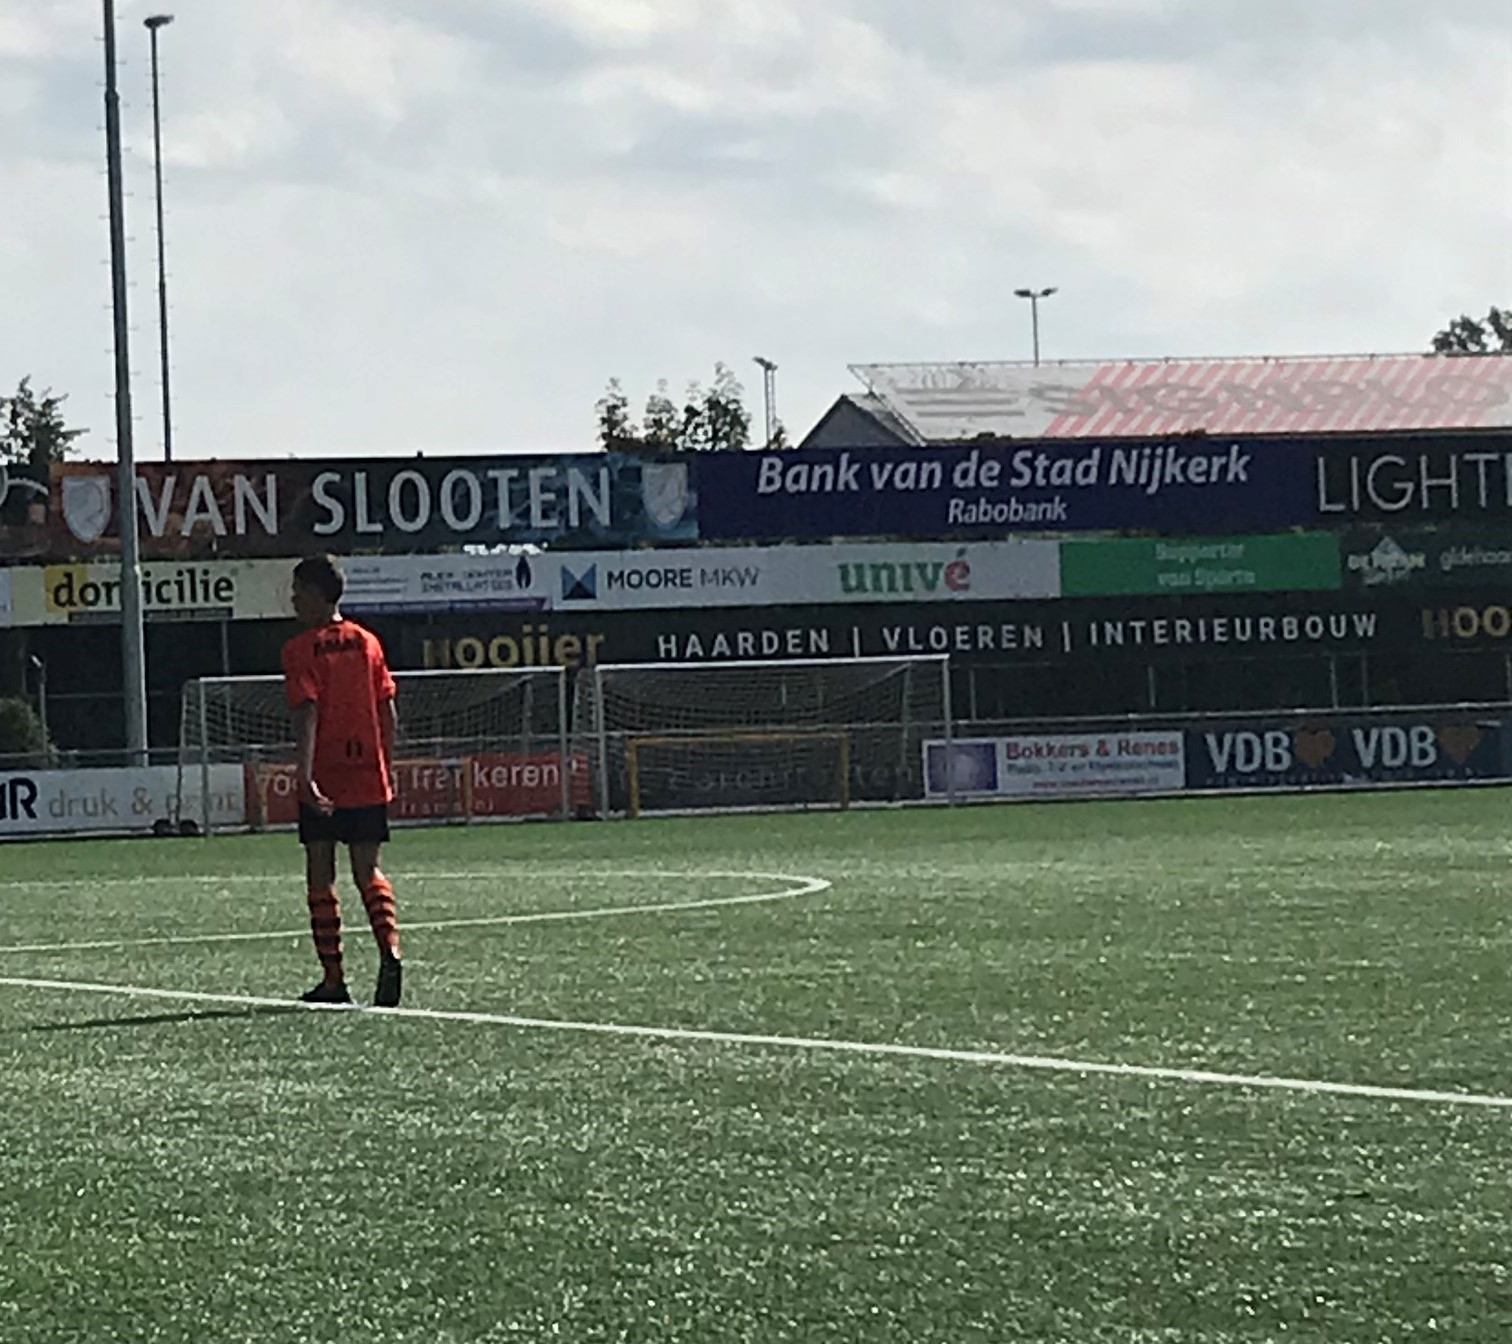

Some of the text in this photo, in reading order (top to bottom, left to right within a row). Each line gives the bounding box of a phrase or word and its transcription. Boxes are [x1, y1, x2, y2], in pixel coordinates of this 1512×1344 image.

[757, 444, 1252, 494] Bank van de Stad Nijkerk
[1318, 454, 1512, 511] LIGHT
[136, 467, 615, 537] VAN SLOOTEN
[948, 497, 1068, 524] Rabobank
[607, 566, 761, 591] MOORE MKW
[838, 548, 971, 594] univé
[657, 613, 1376, 658] HAARDEN VLOEREN INTERIEURBOUW
[1204, 730, 1293, 774] VDB
[1352, 725, 1437, 769] VDB
[49, 787, 119, 818] druk
[131, 786, 153, 816] &
